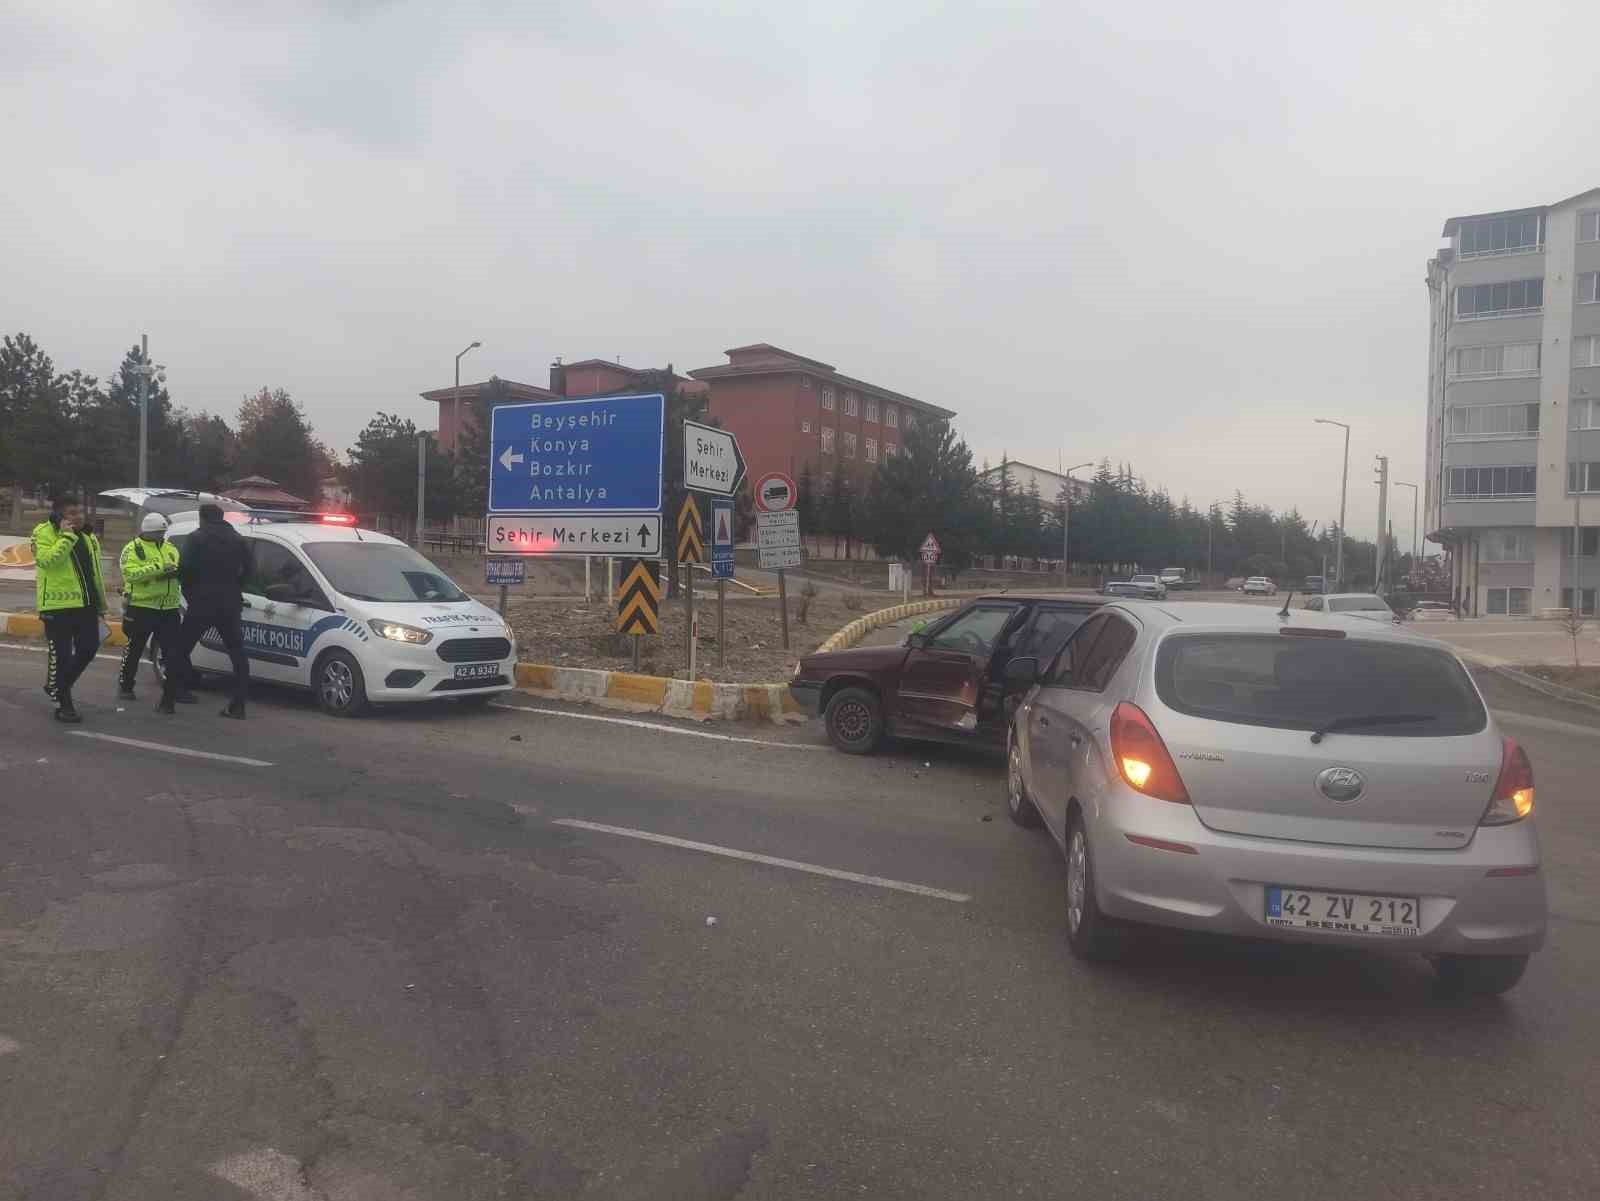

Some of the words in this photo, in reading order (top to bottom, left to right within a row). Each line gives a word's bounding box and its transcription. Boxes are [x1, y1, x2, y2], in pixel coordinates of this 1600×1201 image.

[531, 410, 617, 431] Beyşehir
[530, 437, 590, 455] Konya
[696, 438, 723, 456] Şehir
[530, 461, 592, 476] Bozkır
[690, 460, 729, 482] Merkezi
[530, 484, 608, 502] Antalya
[496, 527, 542, 543] Şehir
[553, 527, 630, 543] Merkezi
[270, 628, 304, 652] POLİSİ
[1283, 893, 1311, 917] 42
[1327, 896, 1354, 919] ZV
[1370, 900, 1414, 924] 212
